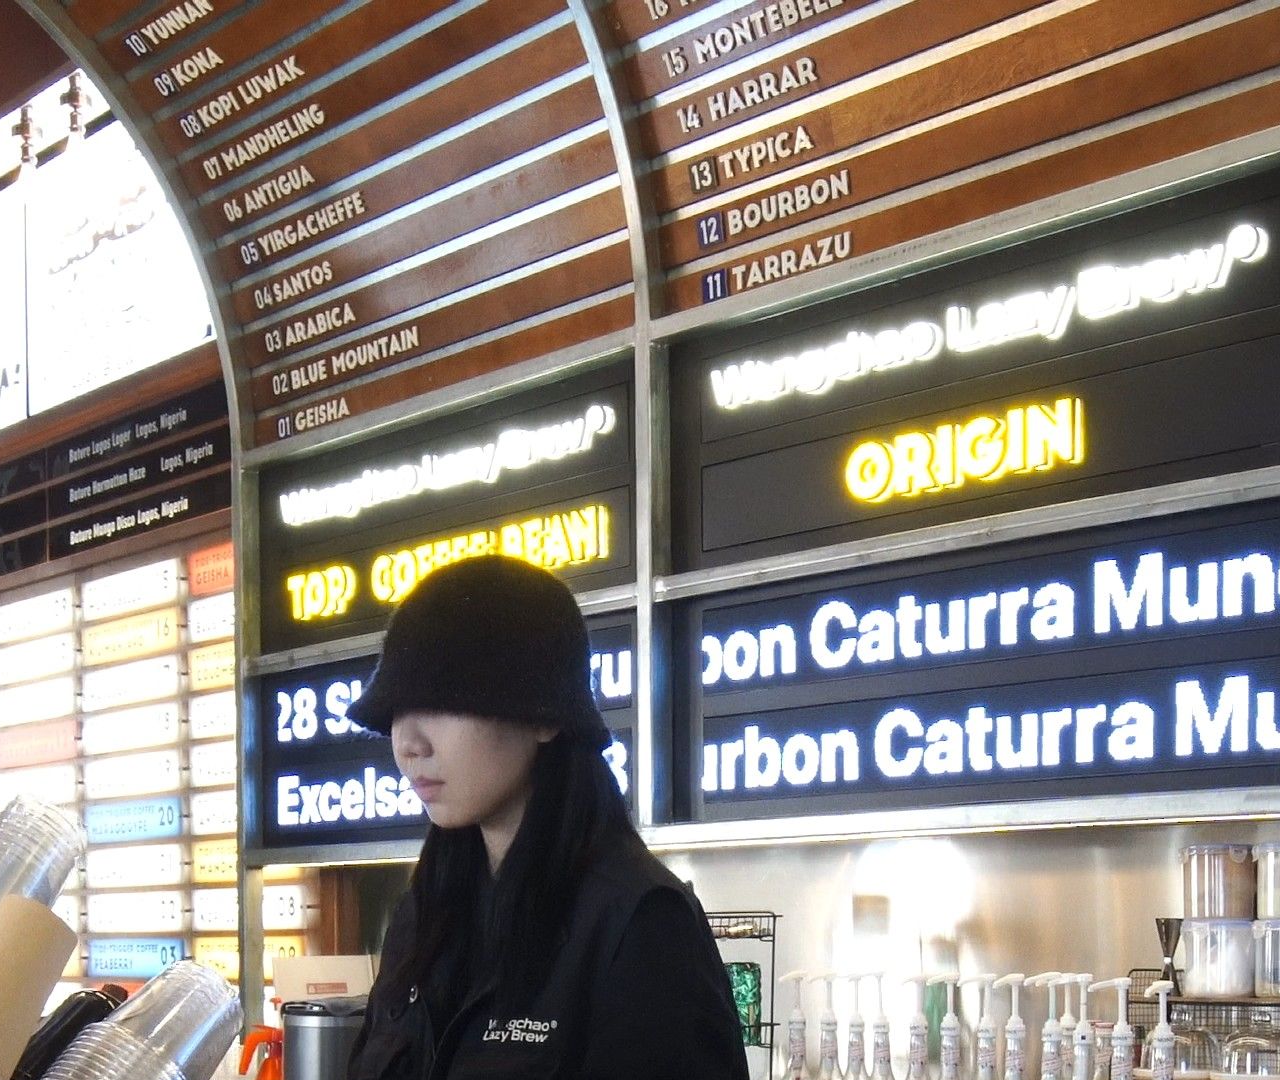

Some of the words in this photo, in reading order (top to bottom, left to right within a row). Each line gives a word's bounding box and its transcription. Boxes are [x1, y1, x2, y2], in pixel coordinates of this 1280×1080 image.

[126, 34, 147, 56] 10
[141, 0, 214, 45] YUNNAN
[153, 72, 175, 97] 09
[171, 47, 224, 86] KONA
[661, 47, 688, 77] 15
[180, 114, 202, 138] 08
[197, 91, 240, 127] KOPI
[237, 56, 306, 105] LUWAK
[676, 104, 702, 133] 14
[707, 57, 818, 122] HARRAR
[203, 156, 223, 179] 07
[221, 104, 325, 171] MANDHELING
[690, 160, 713, 191] 13
[718, 125, 814, 179] TYPICA
[223, 199, 243, 222] 06
[244, 165, 316, 214] ANTIGUA
[700, 216, 720, 245] 12
[727, 169, 851, 236] BOURBON
[240, 242, 259, 265] 05
[257, 191, 365, 256] YIRGACHEFFE
[254, 286, 273, 309] 04
[272, 261, 333, 303] SANTOS
[706, 273, 723, 300] 11
[732, 231, 852, 291] TARRAZU
[265, 332, 282, 353] 03
[285, 303, 356, 347] ARABICA
[272, 374, 289, 395] 02
[291, 359, 327, 390] BLUE
[332, 326, 419, 375] MOUNTAIN
[160, 408, 187, 430] Nigeria
[278, 416, 291, 438] 01
[294, 397, 350, 432] GEISHA
[185, 442, 213, 464] Nigeria
[844, 397, 1085, 502] ORIGIN
[161, 496, 189, 518] Nigeria
[196, 567, 229, 585] GEISHA
[287, 563, 357, 620] TOP
[809, 582, 1074, 670] Caturra
[874, 701, 1153, 779] Caturra
[158, 805, 174, 826] 20
[483, 1030, 509, 1043] Lazy
[511, 1029, 548, 1042] Brew
